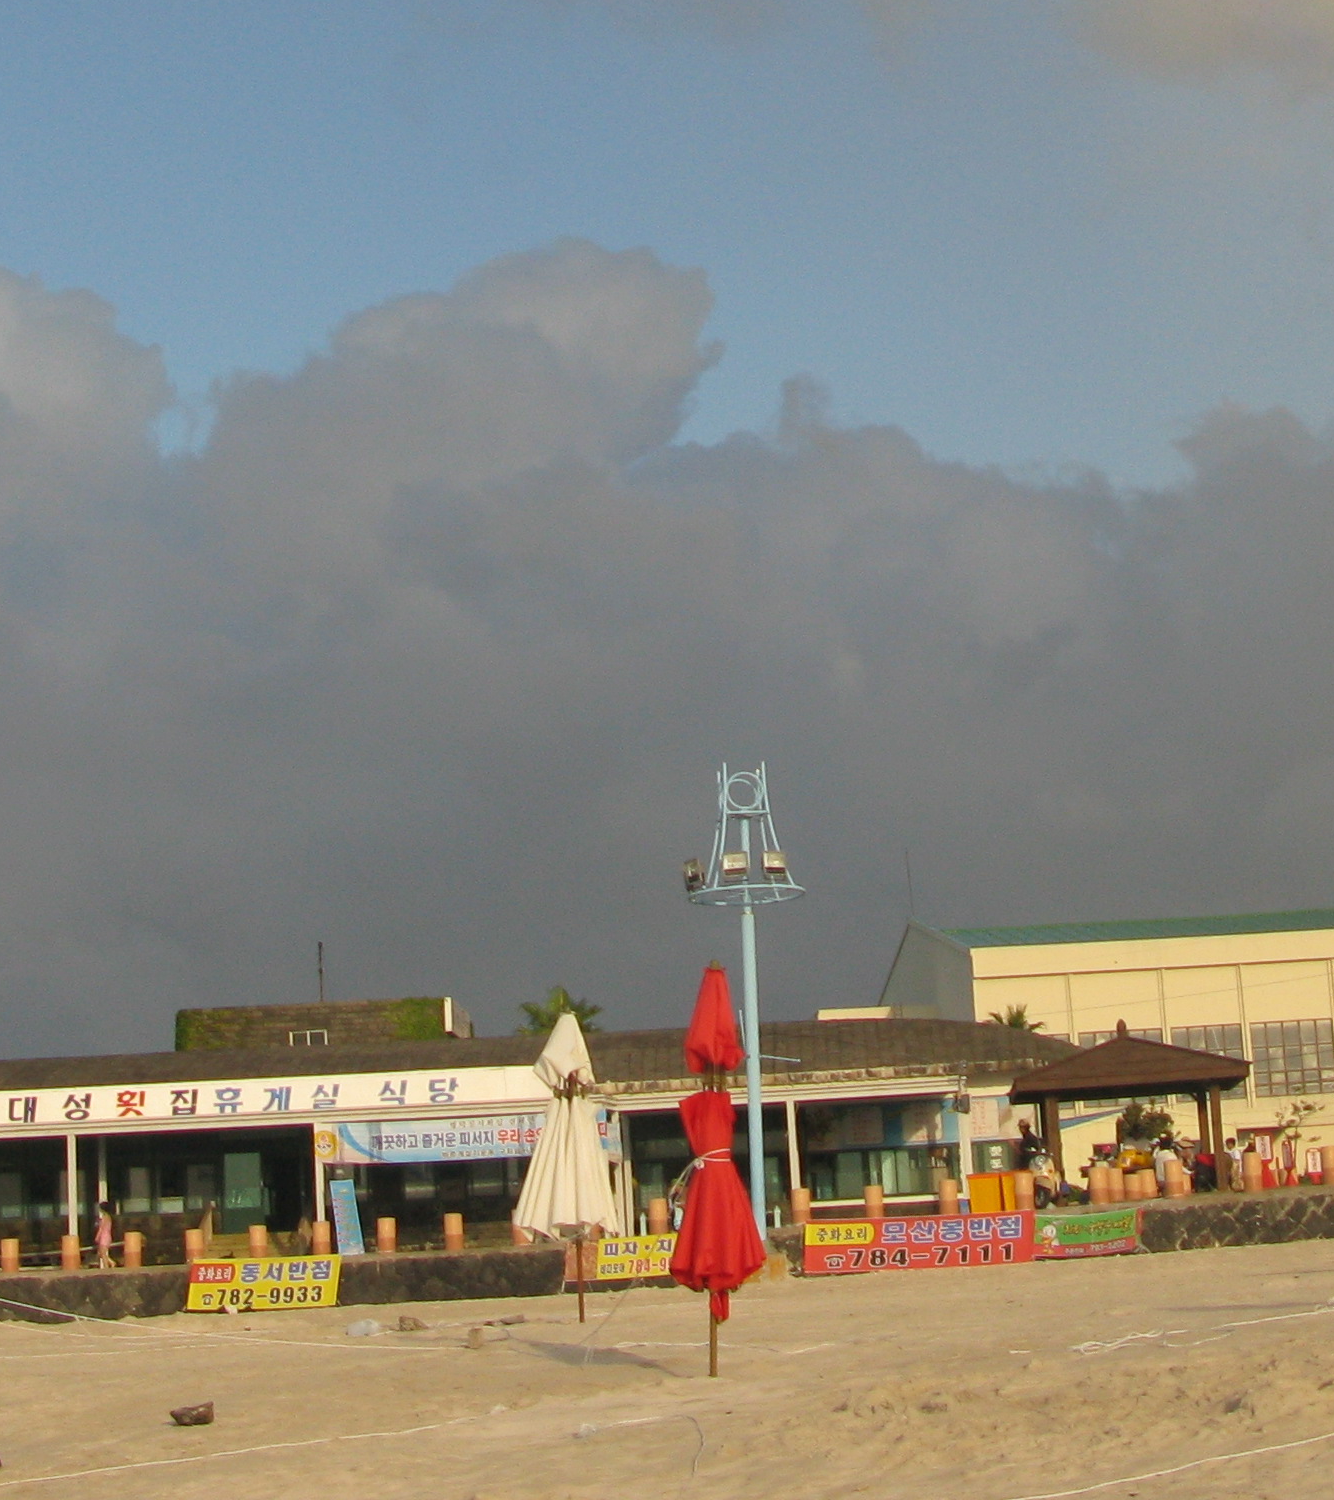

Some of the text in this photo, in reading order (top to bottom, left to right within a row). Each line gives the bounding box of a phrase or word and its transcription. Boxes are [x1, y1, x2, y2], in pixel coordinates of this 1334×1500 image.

[378, 1077, 460, 1106] 식당
[371, 1133, 419, 1151] 깨끗하고
[459, 1129, 495, 1146] 피서지
[497, 1127, 522, 1144] 우리
[816, 1226, 867, 1242] 중화요리
[604, 1241, 638, 1256] 피자
[848, 1242, 1015, 1267] 784-7111
[197, 1259, 333, 1283] 중화요리 동서반점
[628, 1257, 670, 1274] 784-9
[217, 1285, 323, 1306] 782-9933
